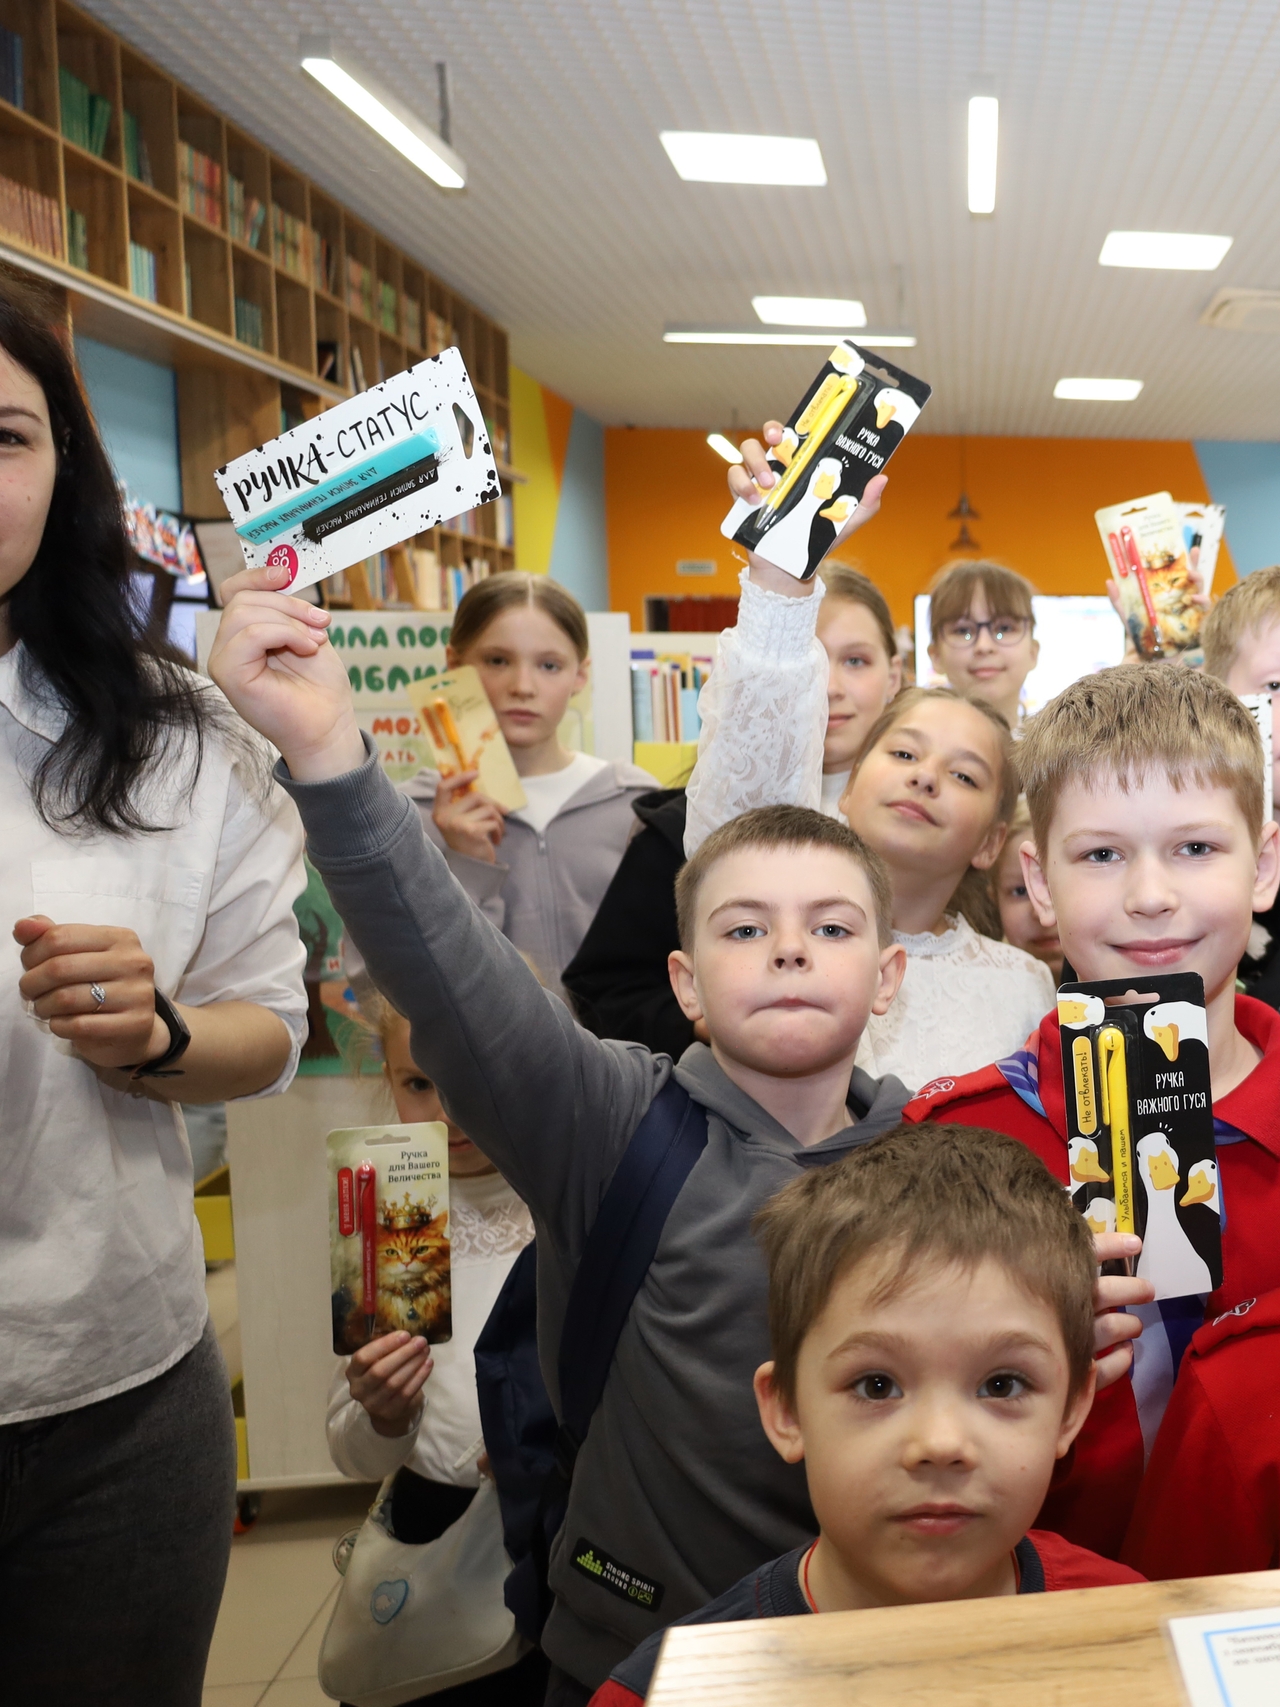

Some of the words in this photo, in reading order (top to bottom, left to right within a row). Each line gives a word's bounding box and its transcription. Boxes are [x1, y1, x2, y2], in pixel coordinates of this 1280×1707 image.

[857, 427, 881, 448] РУЧКА
[835, 434, 867, 460] ВАЖНОГО
[864, 450, 884, 469] ГУСЯ
[358, 466, 378, 483] ДЛЯ
[418, 469, 435, 485] ДЛЯ
[326, 478, 355, 500] ЗАПИСИ
[389, 480, 416, 498] ЗАПИСИ
[279, 492, 328, 524] ГЕНИАЛЬНЫХ
[344, 492, 388, 522] ГЕНИАЛЬНЫХ
[246, 517, 279, 538] МЫСЛЕЙ
[315, 513, 344, 537] МЫСЛЕЙ
[1077, 1051, 1091, 1106] отвлекать!
[1156, 1071, 1184, 1089] РУЧКА
[1137, 1096, 1180, 1115] ВАЖНОГО
[1183, 1092, 1206, 1109] ГУСЯ
[1082, 1108, 1092, 1124] Не
[1119, 1129, 1127, 1157] пашем
[388, 1162, 406, 1172] для
[408, 1160, 440, 1171] Вашего
[400, 1150, 428, 1161] Ручка
[1121, 1157, 1127, 1168] и
[388, 1171, 441, 1183] Величества
[1121, 1171, 1130, 1223] Улыбаемся
[602, 1571, 628, 1590] AROUND
[606, 1562, 630, 1582] STRONG
[631, 1578, 655, 1593] SPIRIT
